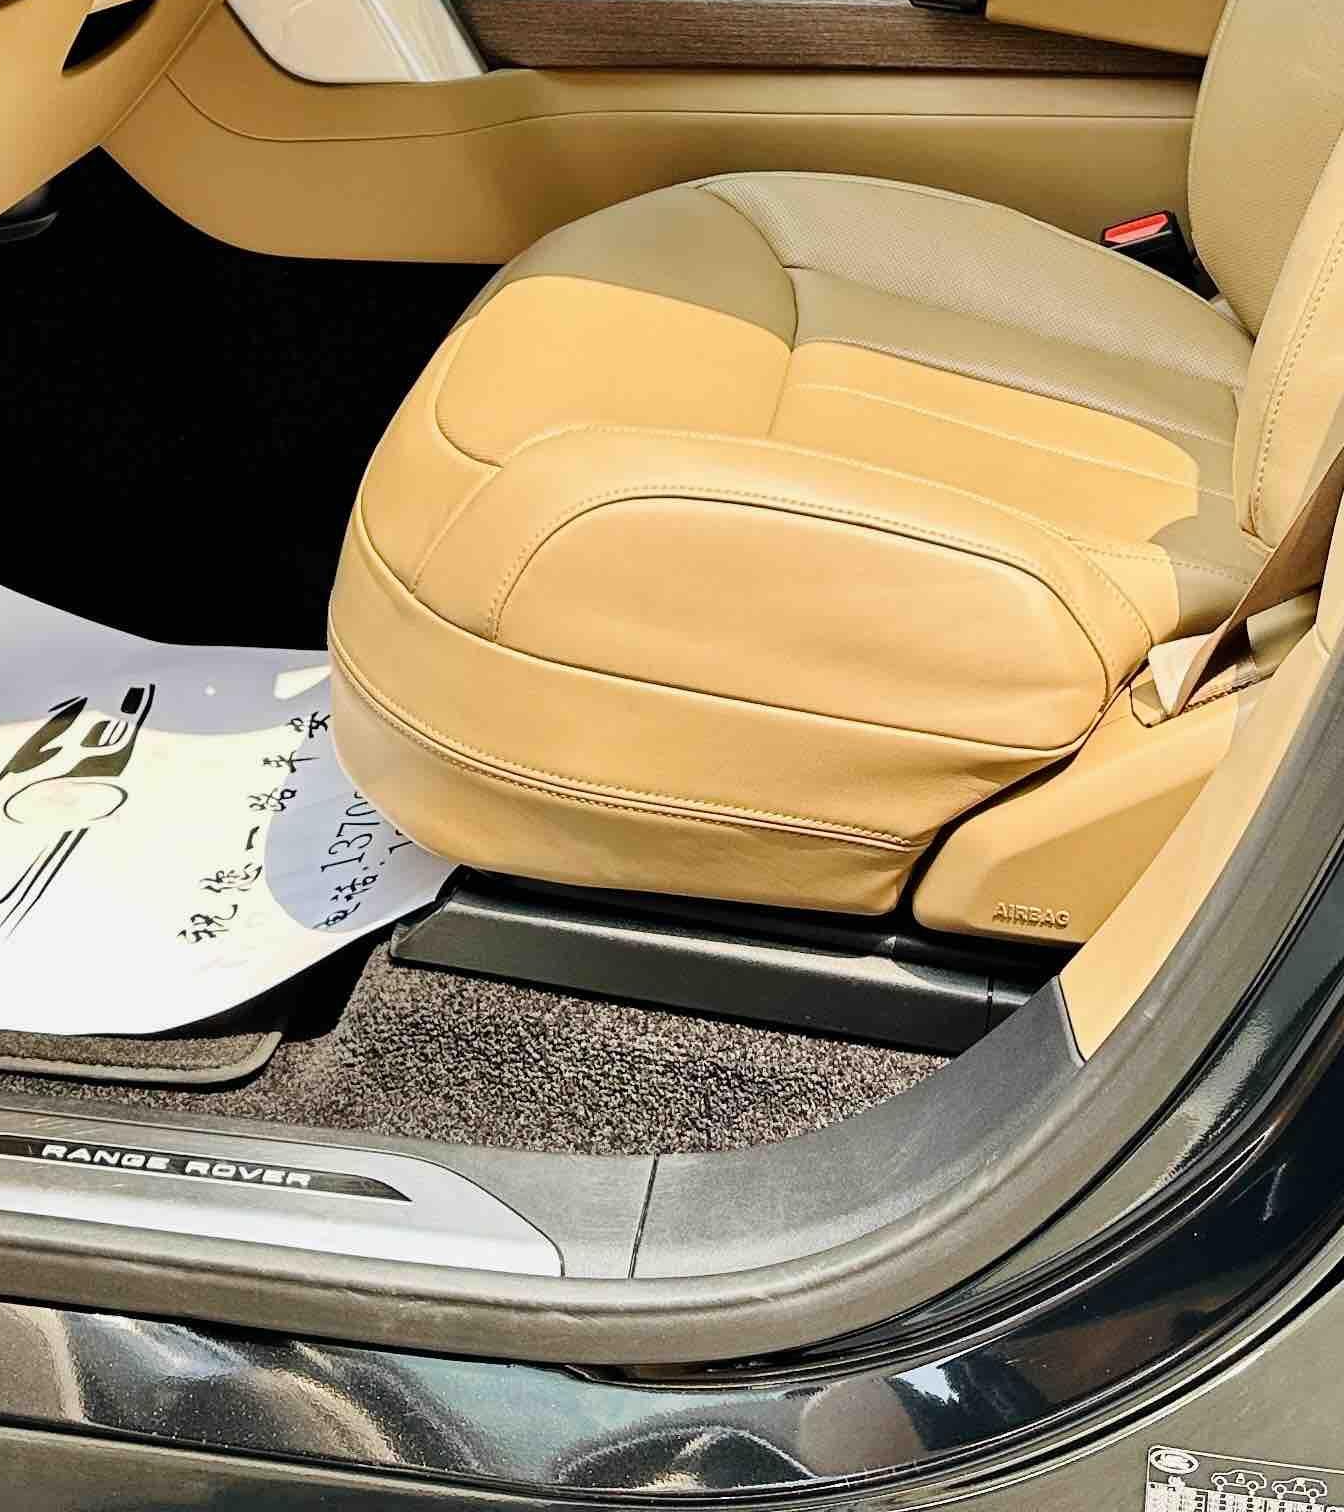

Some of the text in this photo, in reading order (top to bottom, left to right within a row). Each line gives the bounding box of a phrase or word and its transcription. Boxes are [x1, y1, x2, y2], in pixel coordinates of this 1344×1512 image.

[992, 901, 1071, 928] AIRBAG
[40, 1142, 312, 1188] RANGE ROVER
